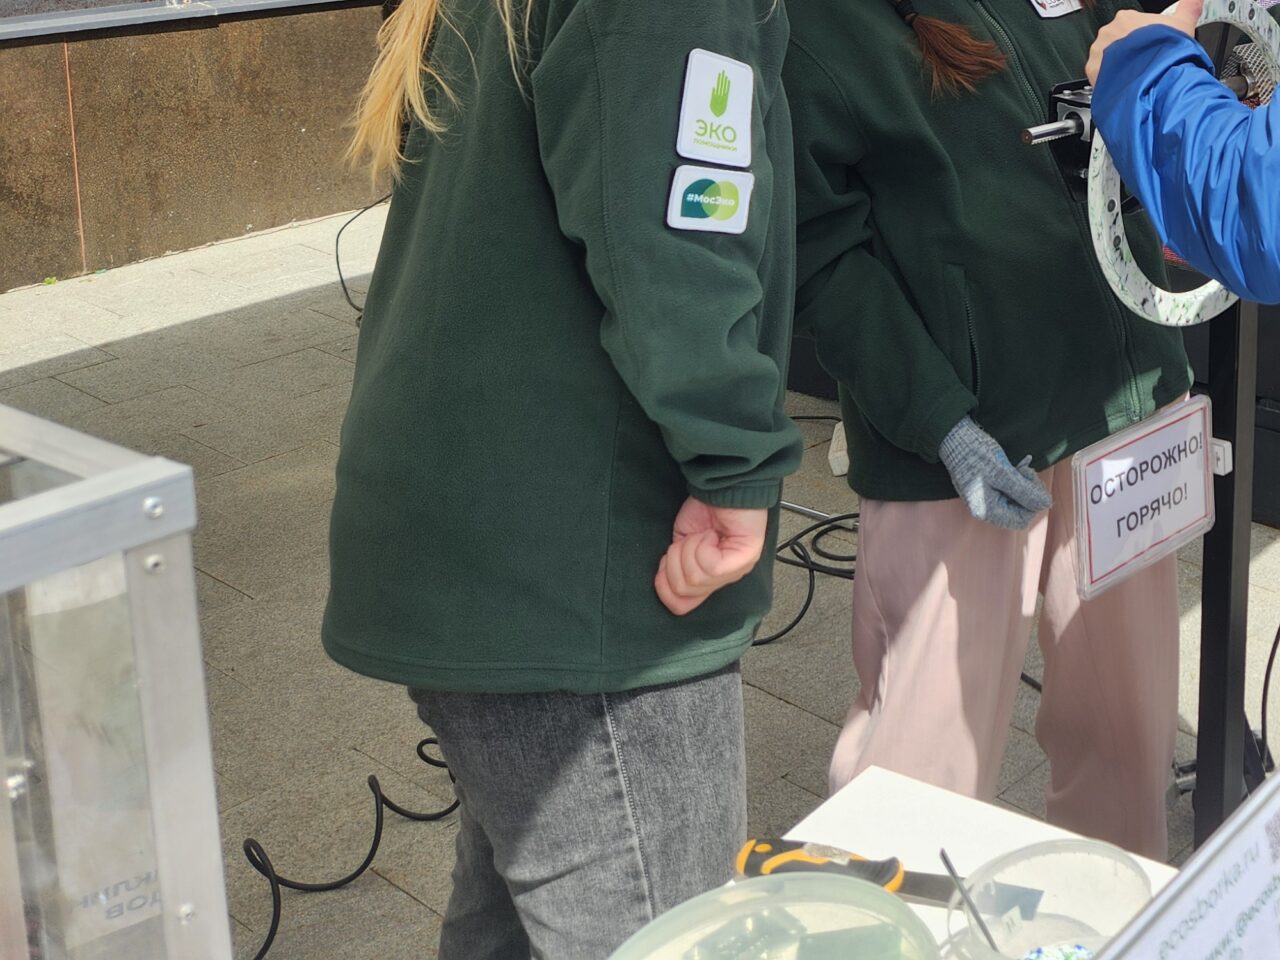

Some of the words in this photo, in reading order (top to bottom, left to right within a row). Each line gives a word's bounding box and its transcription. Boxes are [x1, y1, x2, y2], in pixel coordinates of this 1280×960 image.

[695, 119, 737, 144] ЭКО
[1090, 431, 1204, 505] ОСТОРОЖНО!
[1116, 482, 1189, 538] ГОРЯЧО!
